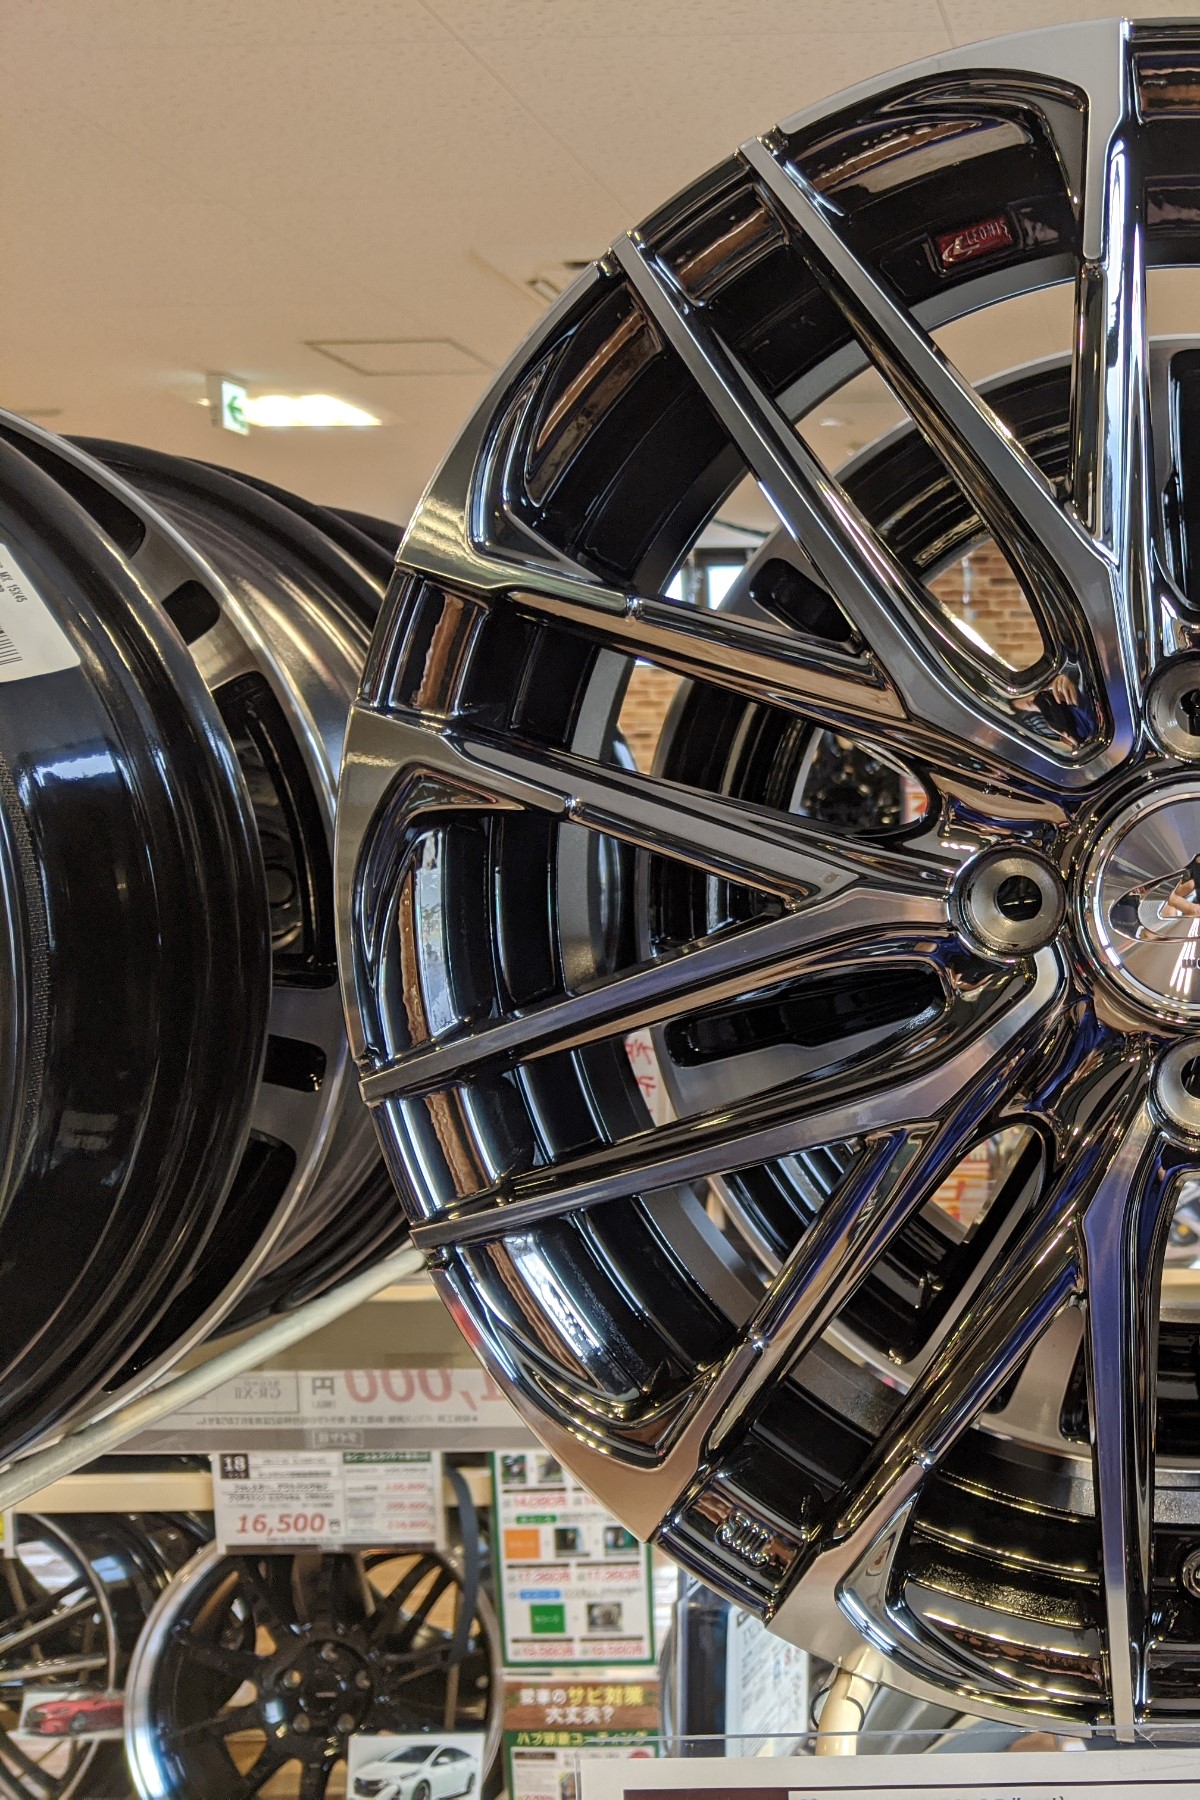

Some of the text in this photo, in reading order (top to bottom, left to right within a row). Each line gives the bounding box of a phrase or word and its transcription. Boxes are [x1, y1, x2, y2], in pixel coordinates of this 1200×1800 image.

[966, 220, 1009, 245] LEONIS
[223, 1456, 247, 1472] 18
[237, 1513, 325, 1536] 16,500
